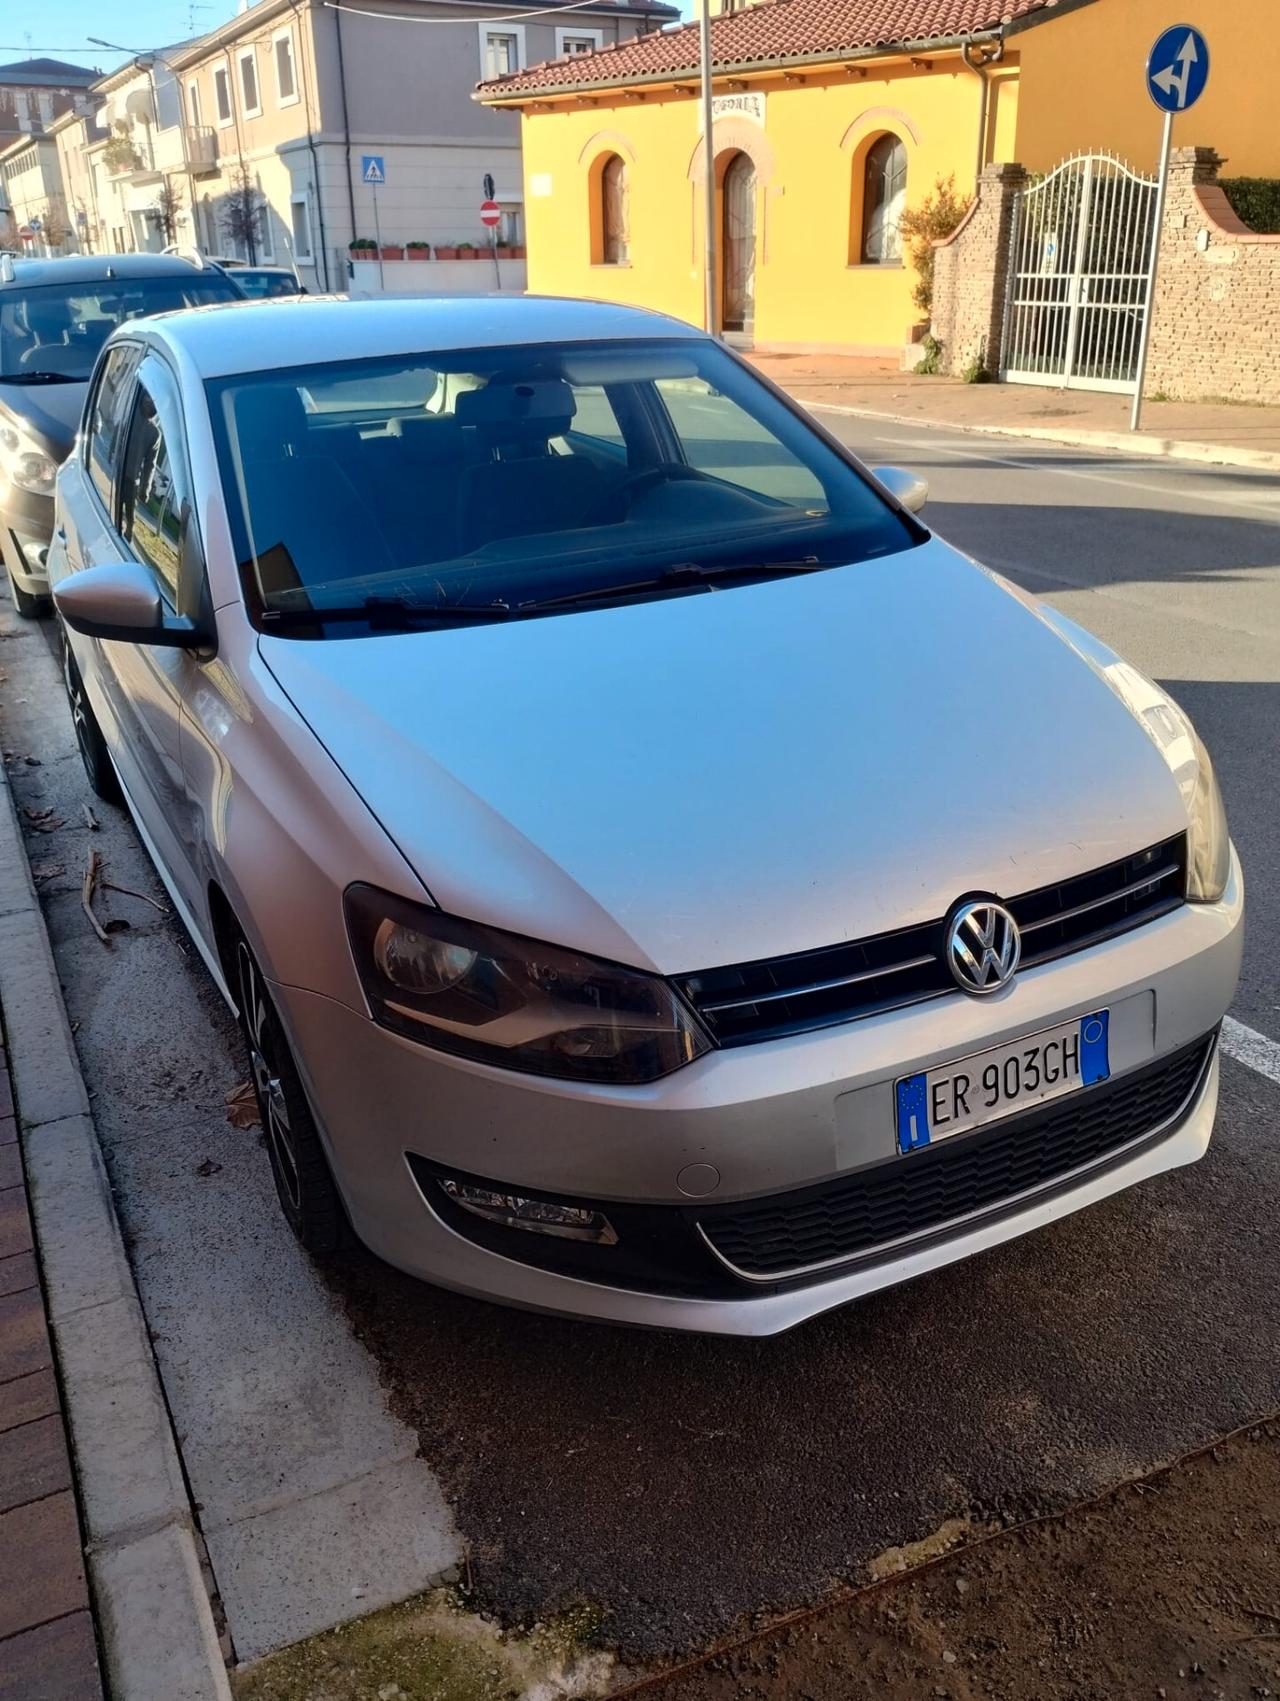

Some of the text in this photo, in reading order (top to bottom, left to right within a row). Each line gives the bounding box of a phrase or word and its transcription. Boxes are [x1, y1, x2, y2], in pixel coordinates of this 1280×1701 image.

[950, 905, 1016, 989] VW
[932, 1032, 1080, 1125] ER 903GH
[910, 1115, 918, 1141] I
